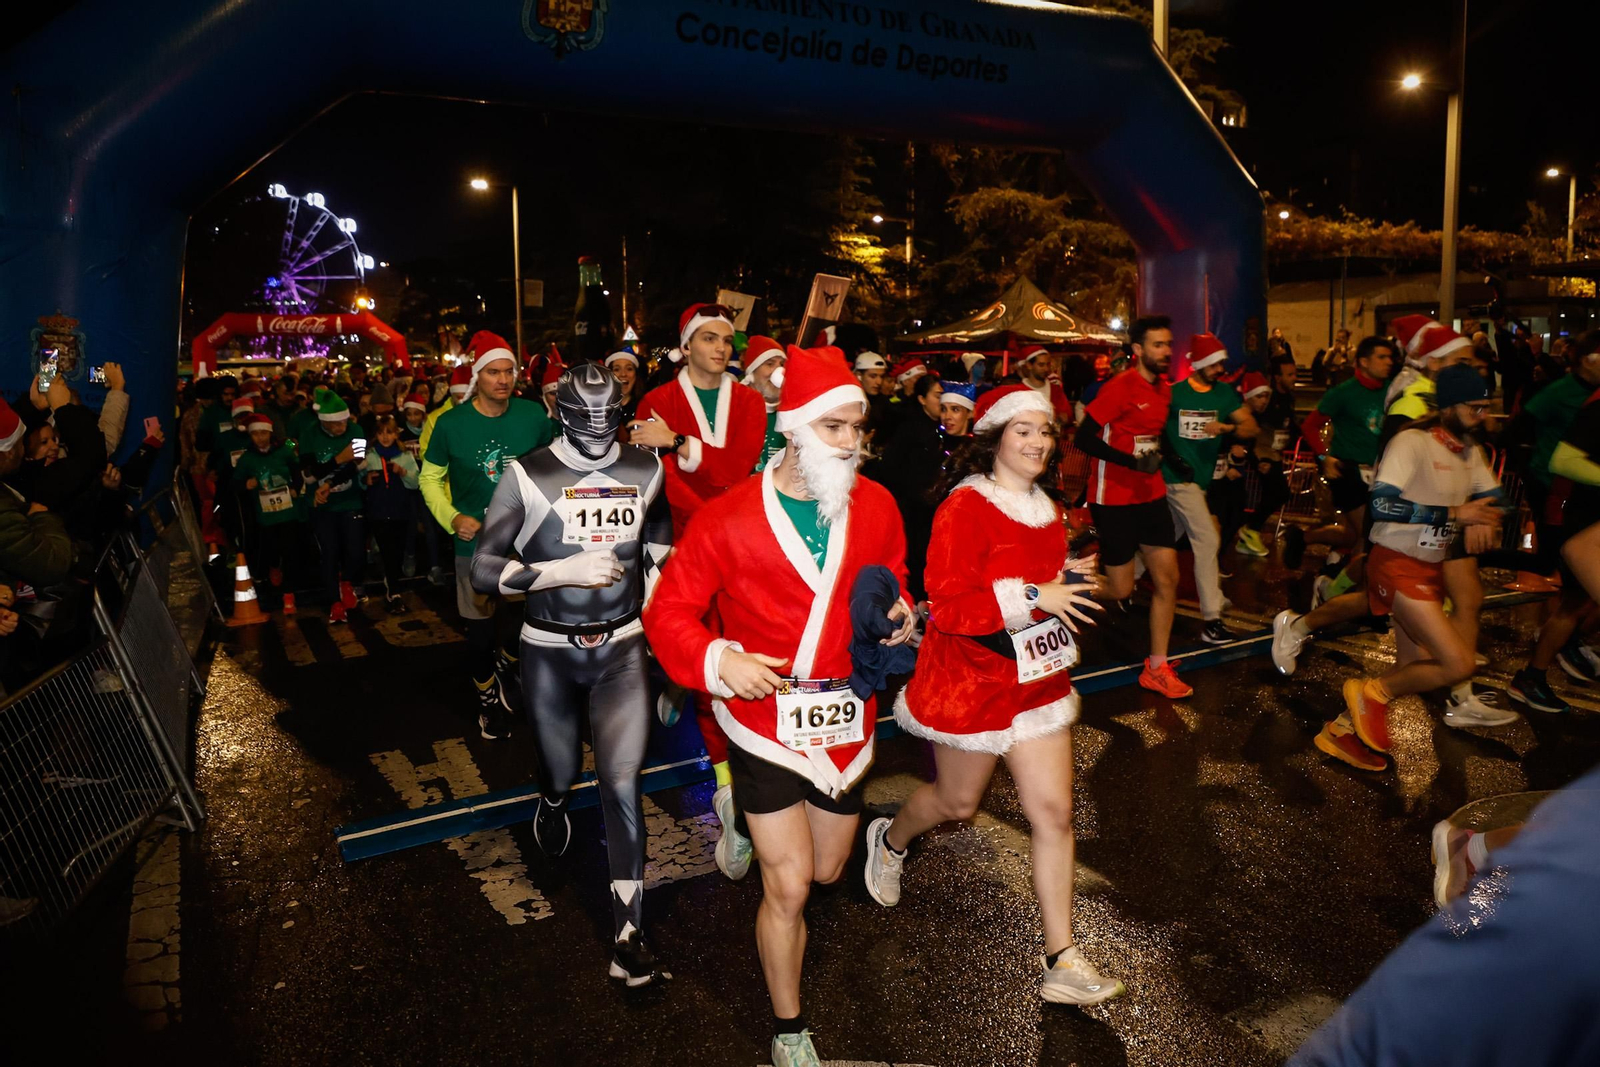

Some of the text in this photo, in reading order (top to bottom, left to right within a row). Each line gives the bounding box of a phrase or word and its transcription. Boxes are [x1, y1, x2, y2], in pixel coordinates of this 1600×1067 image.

[880, 8, 912, 33] DE
[920, 11, 1037, 51] GRANADA
[675, 11, 1009, 83] Concejalía de Deportes
[269, 497, 283, 506] 55
[577, 508, 635, 527] 1140
[1025, 627, 1069, 660] 1600
[790, 701, 856, 728] 1629
